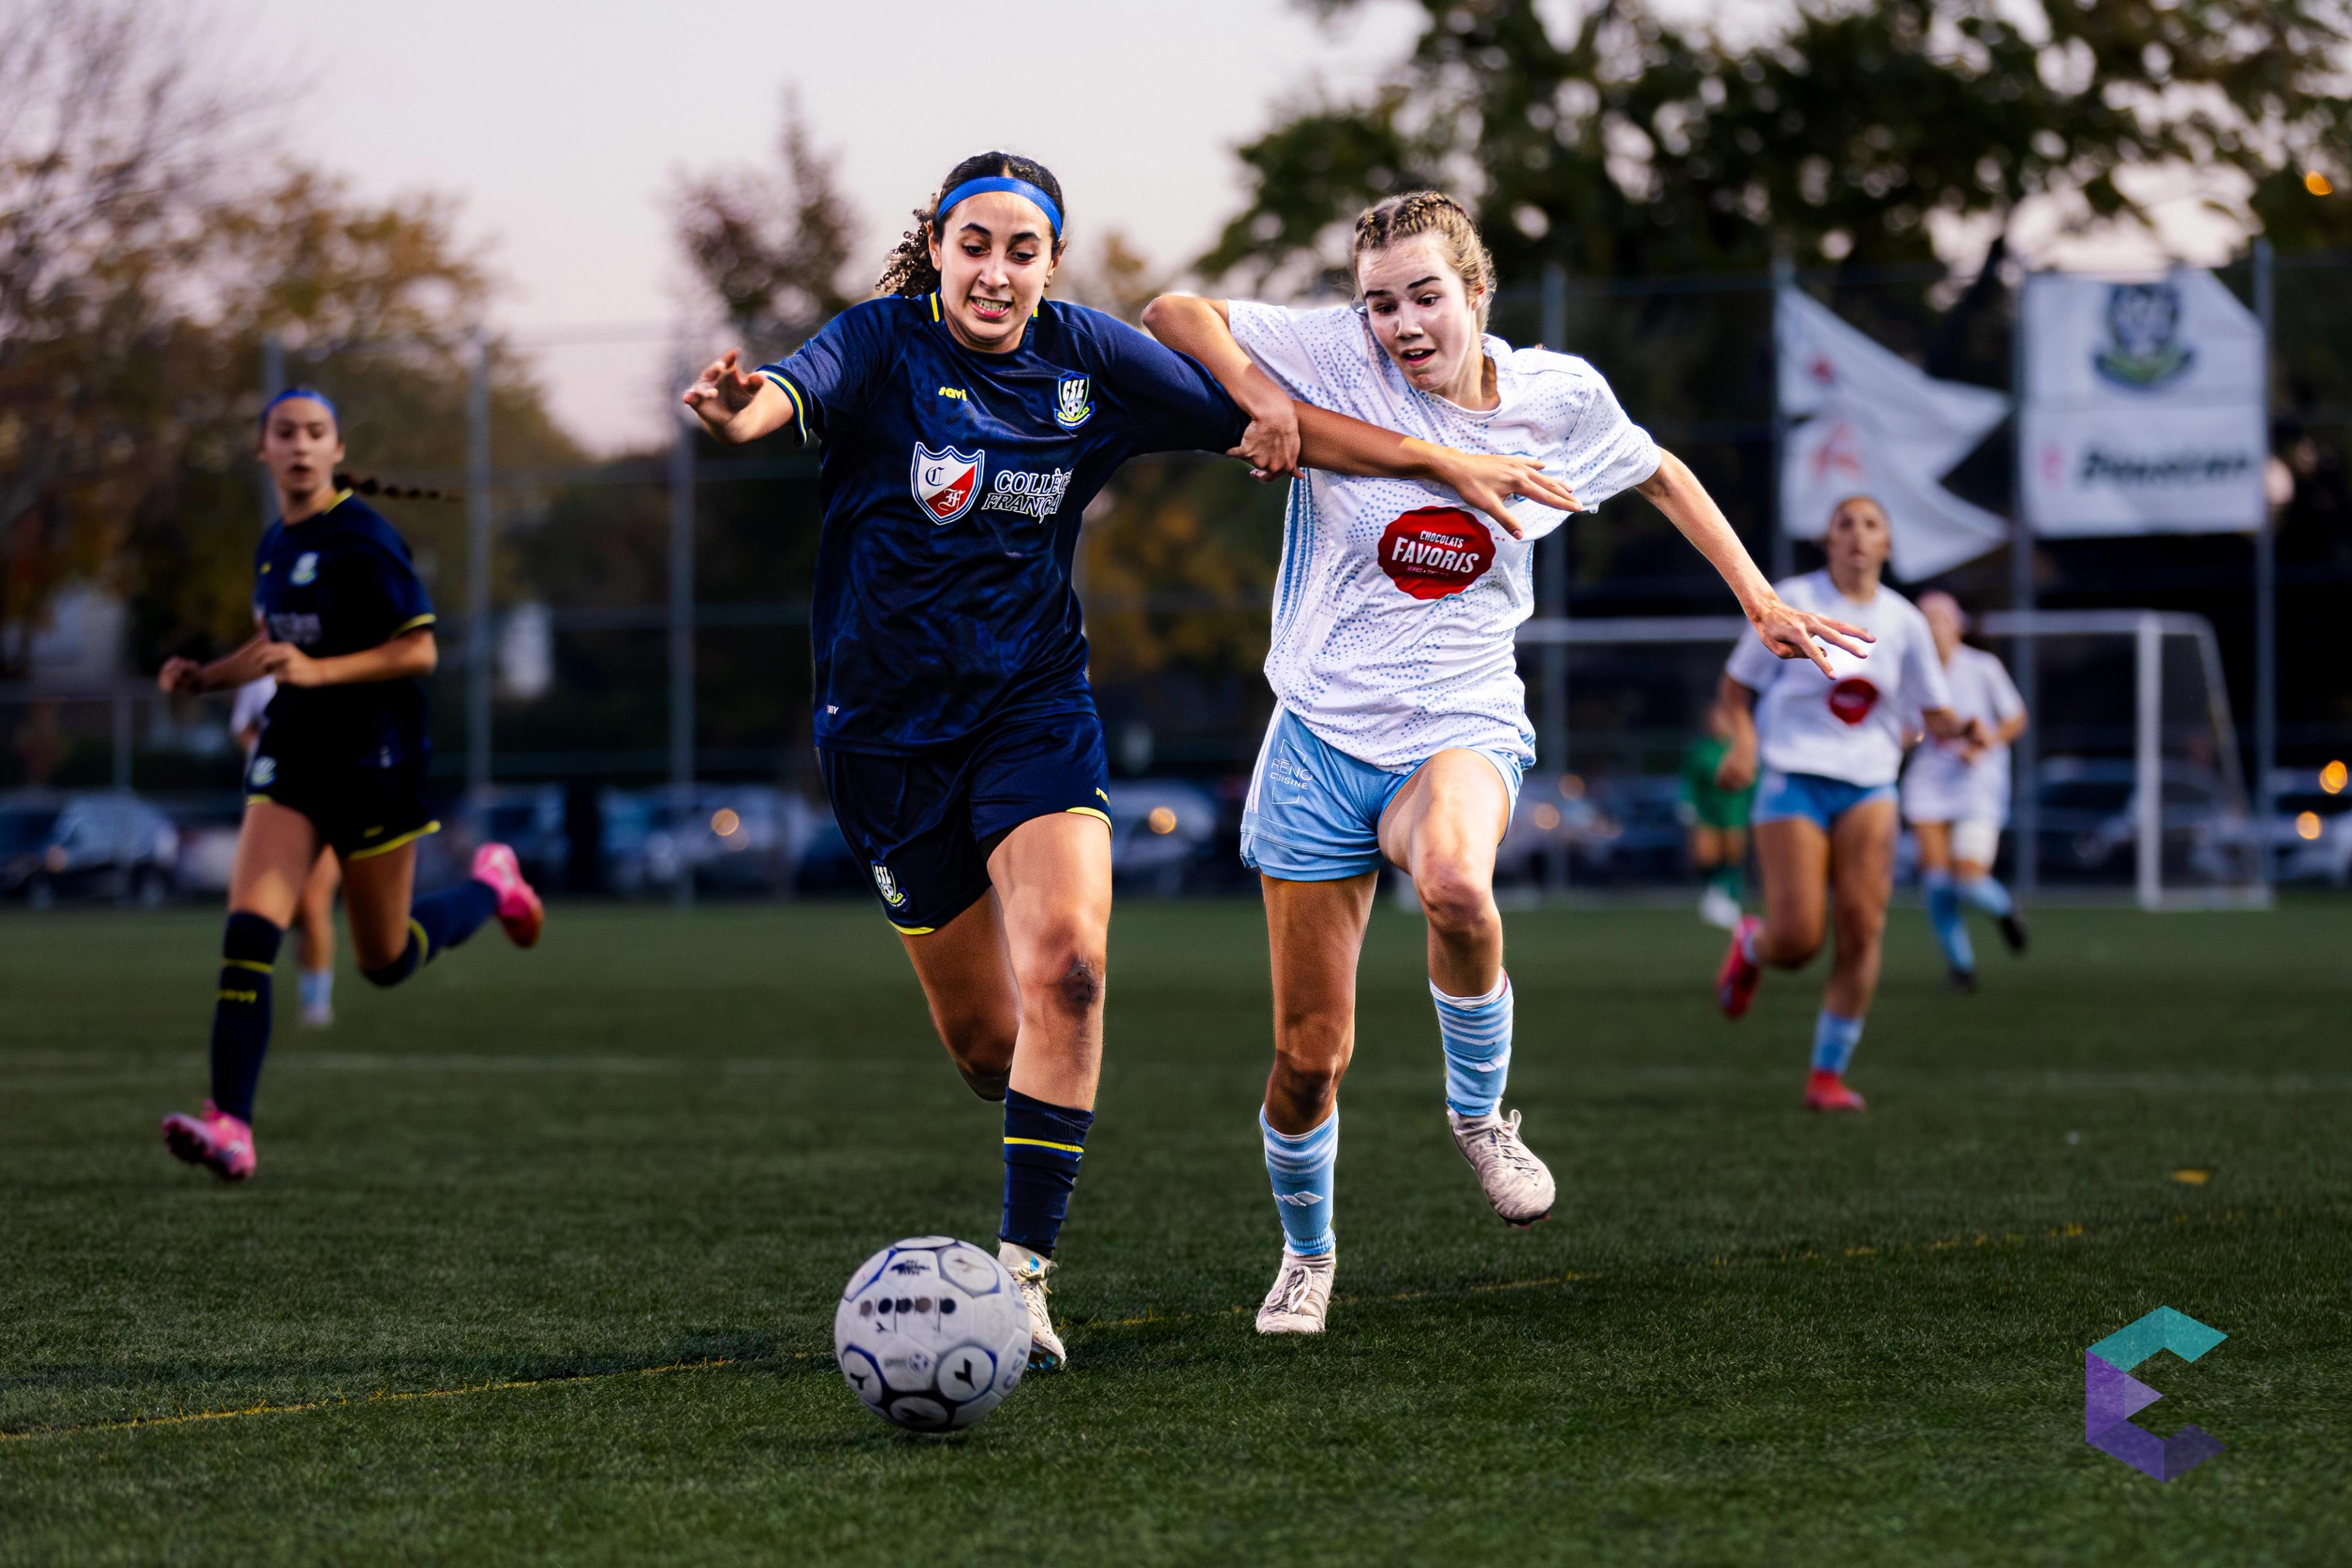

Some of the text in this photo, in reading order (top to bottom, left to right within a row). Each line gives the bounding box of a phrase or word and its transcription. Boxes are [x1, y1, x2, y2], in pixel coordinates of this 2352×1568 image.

[938, 386, 967, 402] savi
[1063, 379, 1085, 401] CSL
[925, 466, 946, 486] C
[1420, 530, 1464, 549] CHOCOLATS
[1391, 537, 1480, 573] FAVORIS
